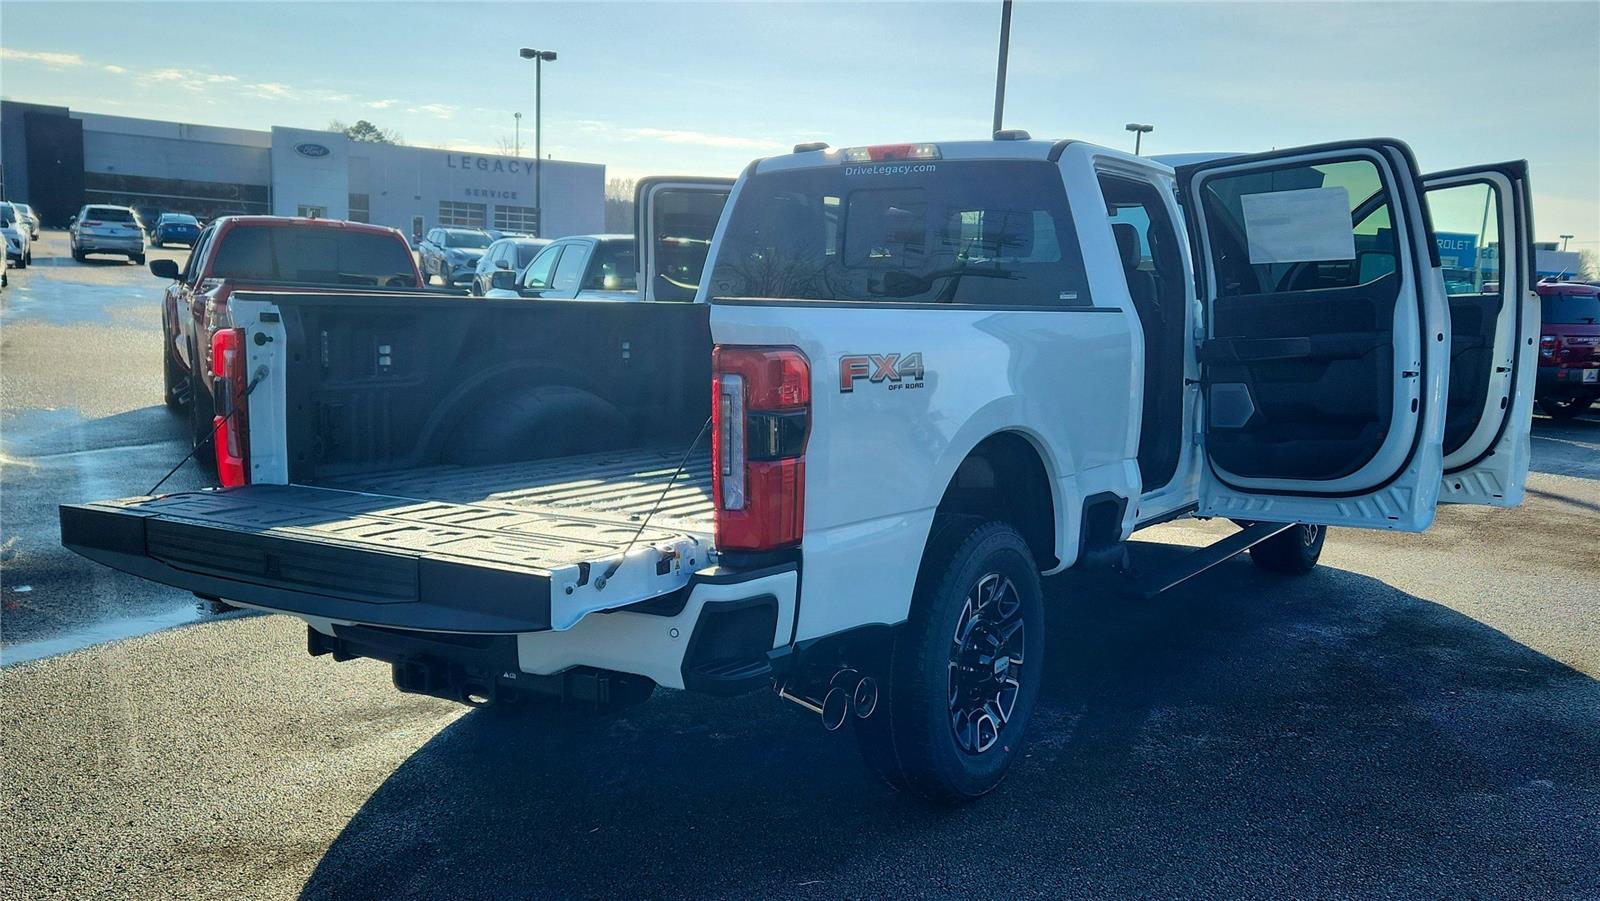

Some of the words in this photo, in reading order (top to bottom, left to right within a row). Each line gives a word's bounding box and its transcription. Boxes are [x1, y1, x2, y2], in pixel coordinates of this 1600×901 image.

[447, 154, 534, 175] LEGACY
[845, 164, 936, 176] DriveLegacy.com
[464, 188, 518, 200] SERVICE
[839, 352, 924, 393] FX4
